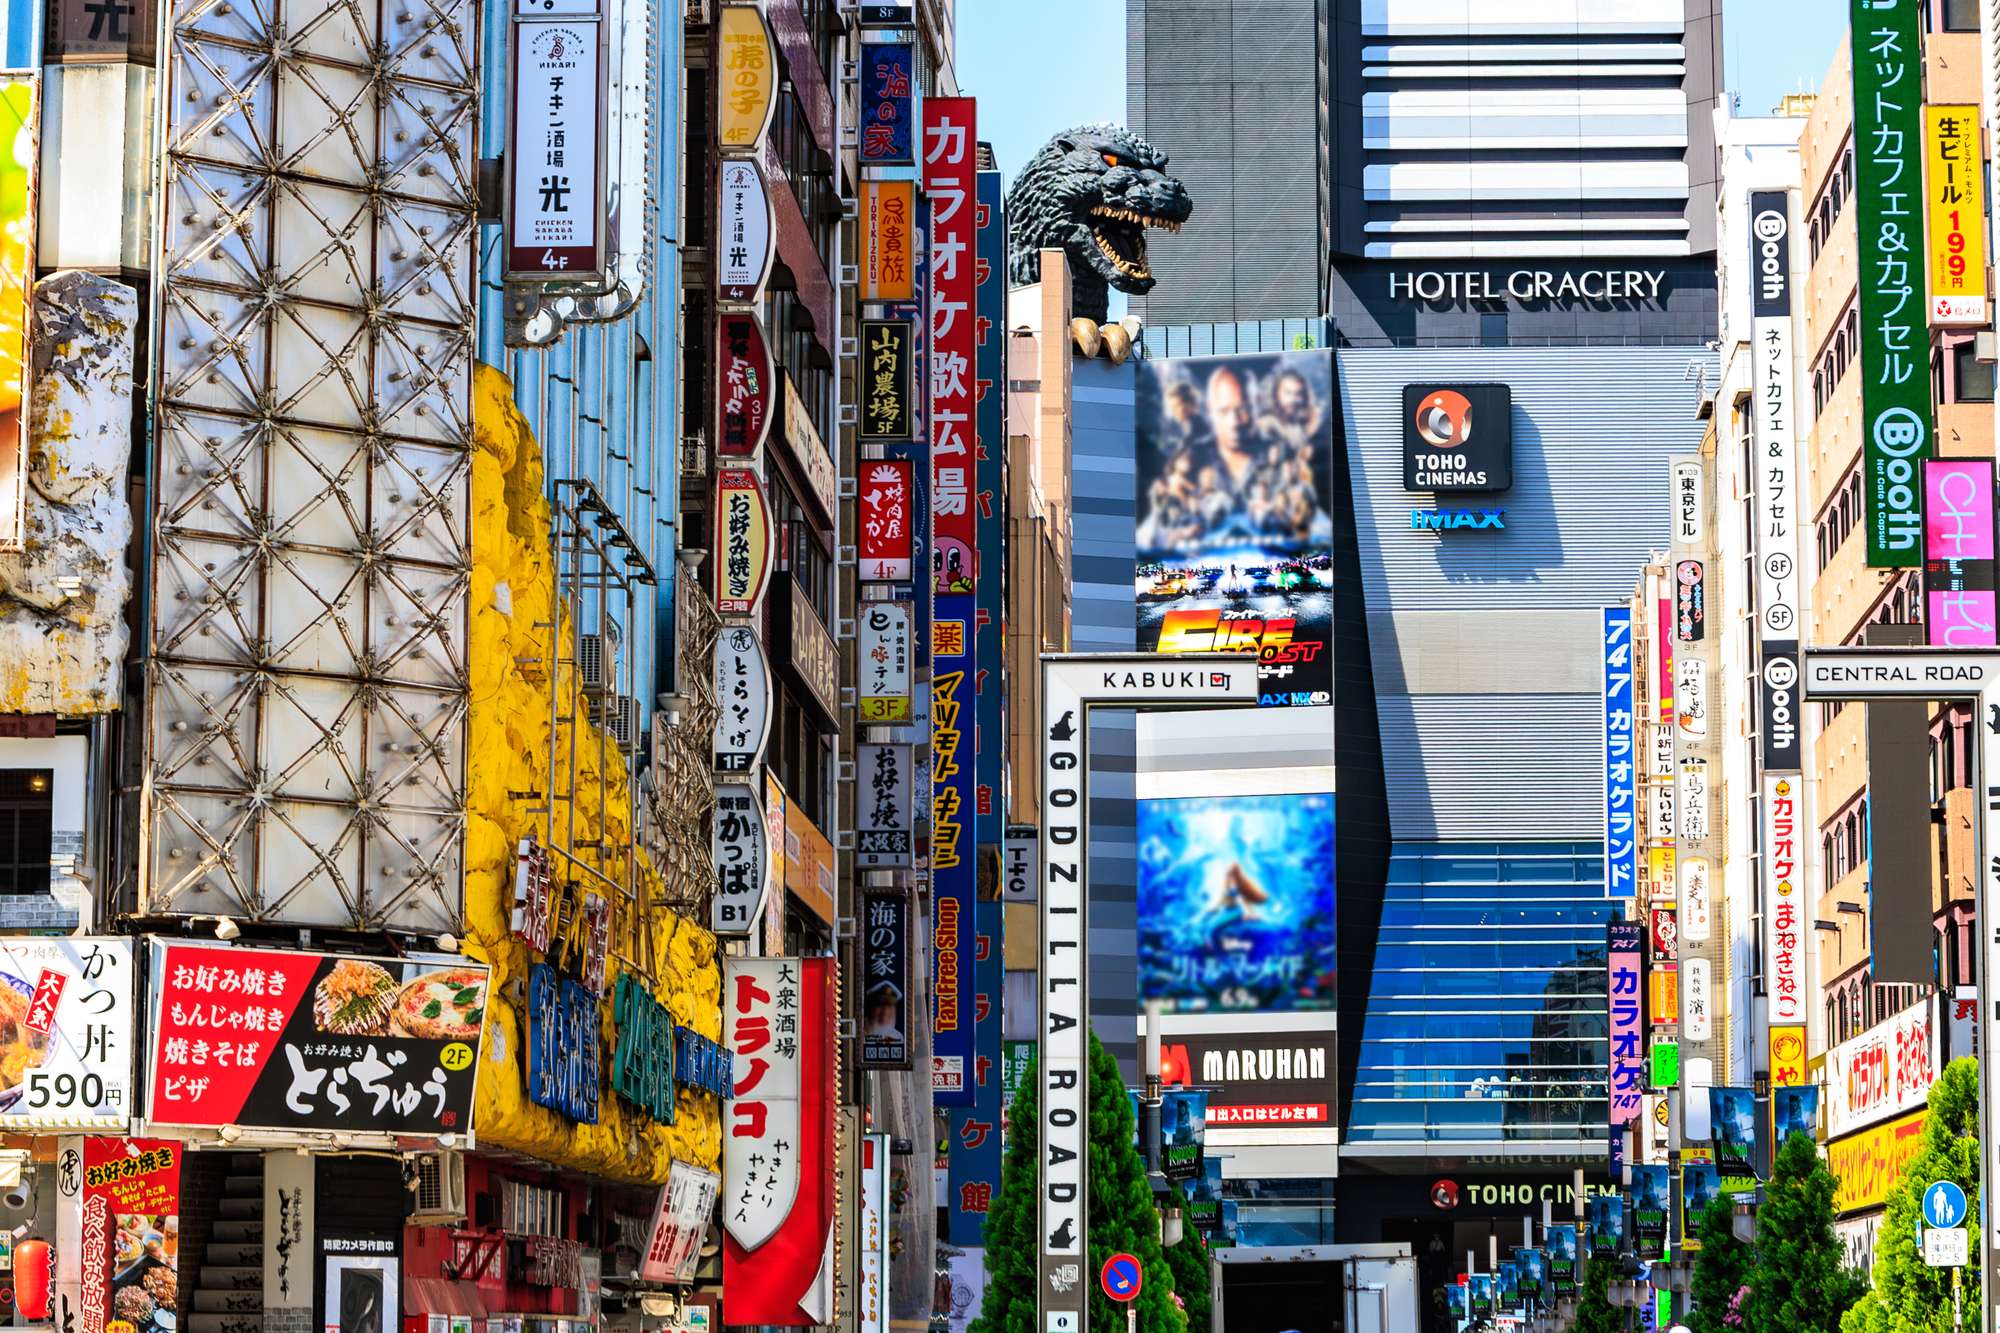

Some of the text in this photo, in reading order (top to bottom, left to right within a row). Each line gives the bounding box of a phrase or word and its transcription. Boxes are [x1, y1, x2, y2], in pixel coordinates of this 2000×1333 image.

[879, 7, 894, 18] 8F
[727, 45, 764, 115] 虎の子
[863, 64, 911, 157] 海の家
[539, 76, 571, 213] チキン酒場 光
[724, 128, 750, 142] 4F
[1938, 118, 1962, 204] 生ビール
[541, 249, 568, 270] 4F
[730, 247, 747, 267] 光
[730, 286, 744, 298] 4F
[1390, 270, 1666, 299] HOTEL GRACERY
[869, 327, 900, 421] 山内農場
[752, 400, 761, 429] 3F
[877, 421, 893, 433] 5F
[1415, 454, 1466, 470] TOHO
[1415, 471, 1487, 486] CINEMAS
[1873, 407, 1924, 549] Booth
[885, 485, 904, 538] 焼肉屋
[1410, 508, 1507, 529] IMAX
[1681, 478, 1697, 537] 東京ビル
[728, 493, 750, 597] お好み焼き
[873, 561, 896, 578] 4F
[719, 601, 748, 611] 2階
[1771, 560, 1788, 624] 8F 5F
[933, 624, 960, 653] 薬
[1816, 666, 1983, 681] CENTRAL ROAD
[872, 700, 898, 716] 3F
[723, 755, 747, 769] 1F
[1606, 620, 1633, 888] 747 カラオケランド
[719, 812, 751, 894] かっぱ
[721, 905, 746, 921] B1
[936, 896, 960, 950] Shop
[1773, 798, 1798, 1017] カラオケ まねきねこ
[869, 901, 896, 975] 海の家
[172, 964, 287, 996] お好み焼き
[936, 950, 959, 998] Free
[1049, 752, 1077, 1203] GODZILLA ROAD
[27, 974, 61, 1031] 大人気
[79, 944, 117, 1063] かつ丼
[171, 1002, 285, 1031] もんじゃ焼き
[774, 964, 797, 1059] 大衆酒場
[936, 999, 959, 1034] Tax
[1612, 967, 1639, 1090] カラオケ
[164, 1039, 260, 1066] 焼きそば
[303, 1044, 363, 1058] お好み焼き
[445, 1048, 467, 1064] 2F
[732, 974, 771, 1139] トラノコ
[1203, 1048, 1325, 1080] MARUHAN
[165, 1077, 210, 1102] ピザ
[285, 1043, 447, 1118] とらぢゅう
[1613, 1094, 1640, 1110] 747
[87, 1149, 173, 1186] お好み焼き
[761, 1139, 789, 1208] やきとり
[734, 1153, 764, 1223] やきとん
[1467, 1185, 1616, 1204] TOHO CINEM
[83, 1194, 107, 1333] 食べ飲み放題
